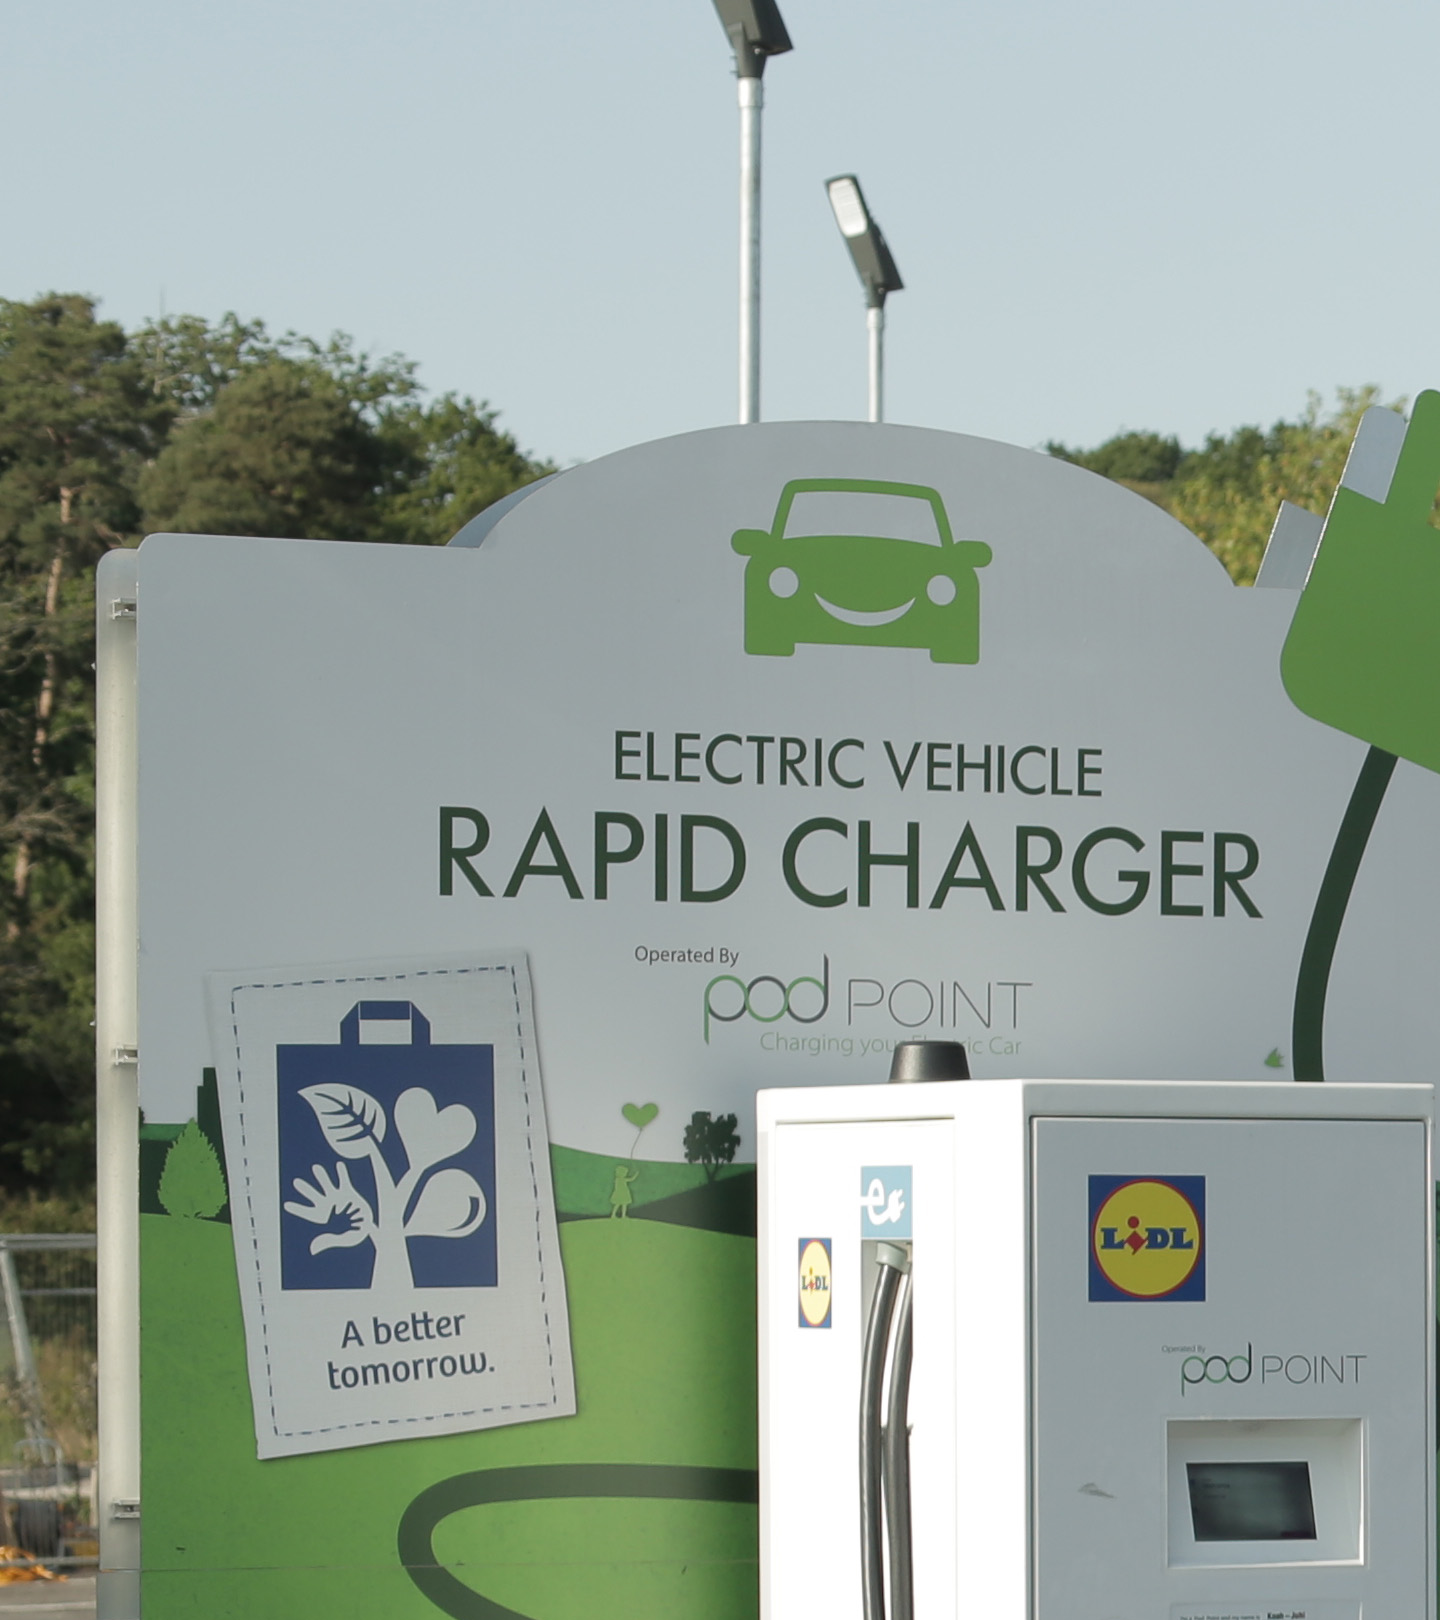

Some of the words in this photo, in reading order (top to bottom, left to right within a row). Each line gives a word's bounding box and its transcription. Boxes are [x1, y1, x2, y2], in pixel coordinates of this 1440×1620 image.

[614, 730, 865, 790] ELECTRIC
[883, 740, 1103, 797] VEHICLE
[438, 805, 747, 904] RAPID
[781, 815, 1264, 919] CHARGER
[635, 945, 714, 965] Operated
[719, 947, 740, 967] By
[703, 953, 829, 1046] pod
[848, 978, 1033, 1029] POINT
[760, 1031, 853, 1057] Charging
[860, 1037, 900, 1058] you
[989, 1037, 1022, 1057] Car
[341, 1319, 364, 1349] A
[372, 1311, 467, 1346] better
[1161, 1345, 1196, 1354] Operated
[327, 1352, 496, 1391] tomorrow.
[1181, 1341, 1253, 1397] pod
[1261, 1355, 1368, 1384] POINT
